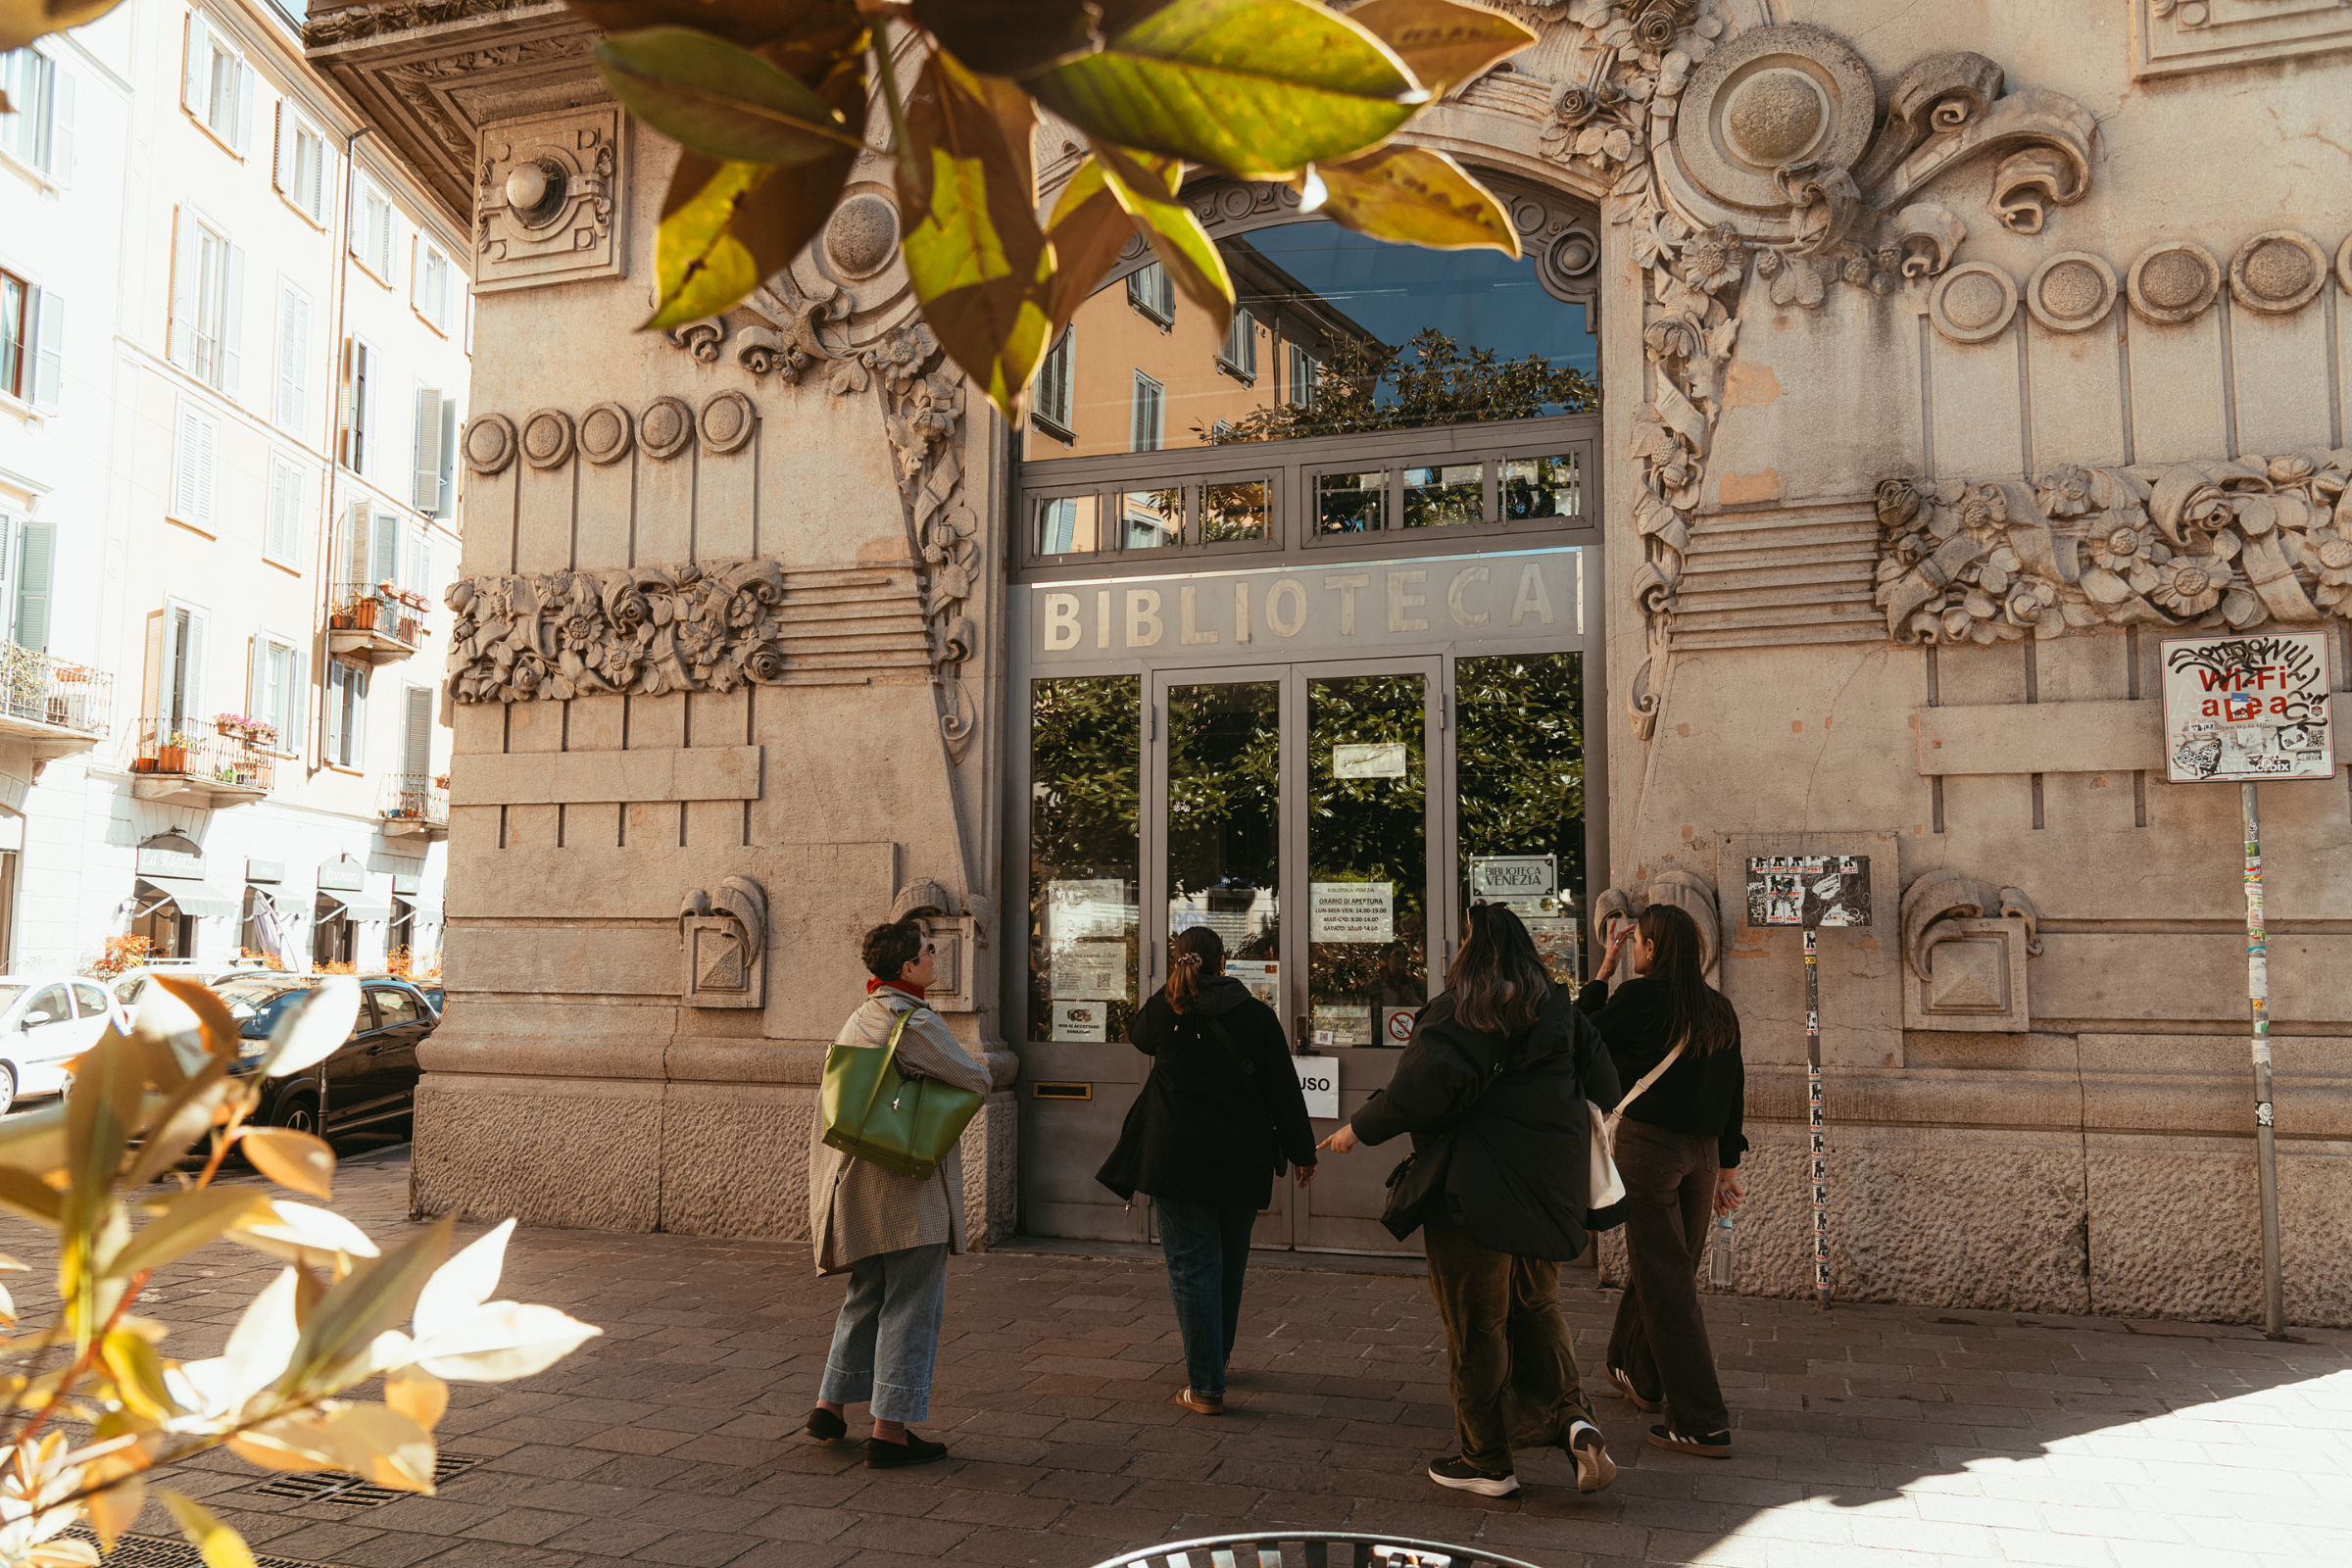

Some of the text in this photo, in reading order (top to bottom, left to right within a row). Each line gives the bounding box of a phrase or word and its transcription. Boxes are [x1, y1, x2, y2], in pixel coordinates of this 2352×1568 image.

[1044, 562, 1556, 652] BIBLIOTECA
[140, 849, 205, 875] La Ragazza
[1486, 866, 1542, 876] BIBLIOTECA
[324, 866, 361, 884] Ristorante
[1486, 875, 1542, 886] VENEZIA
